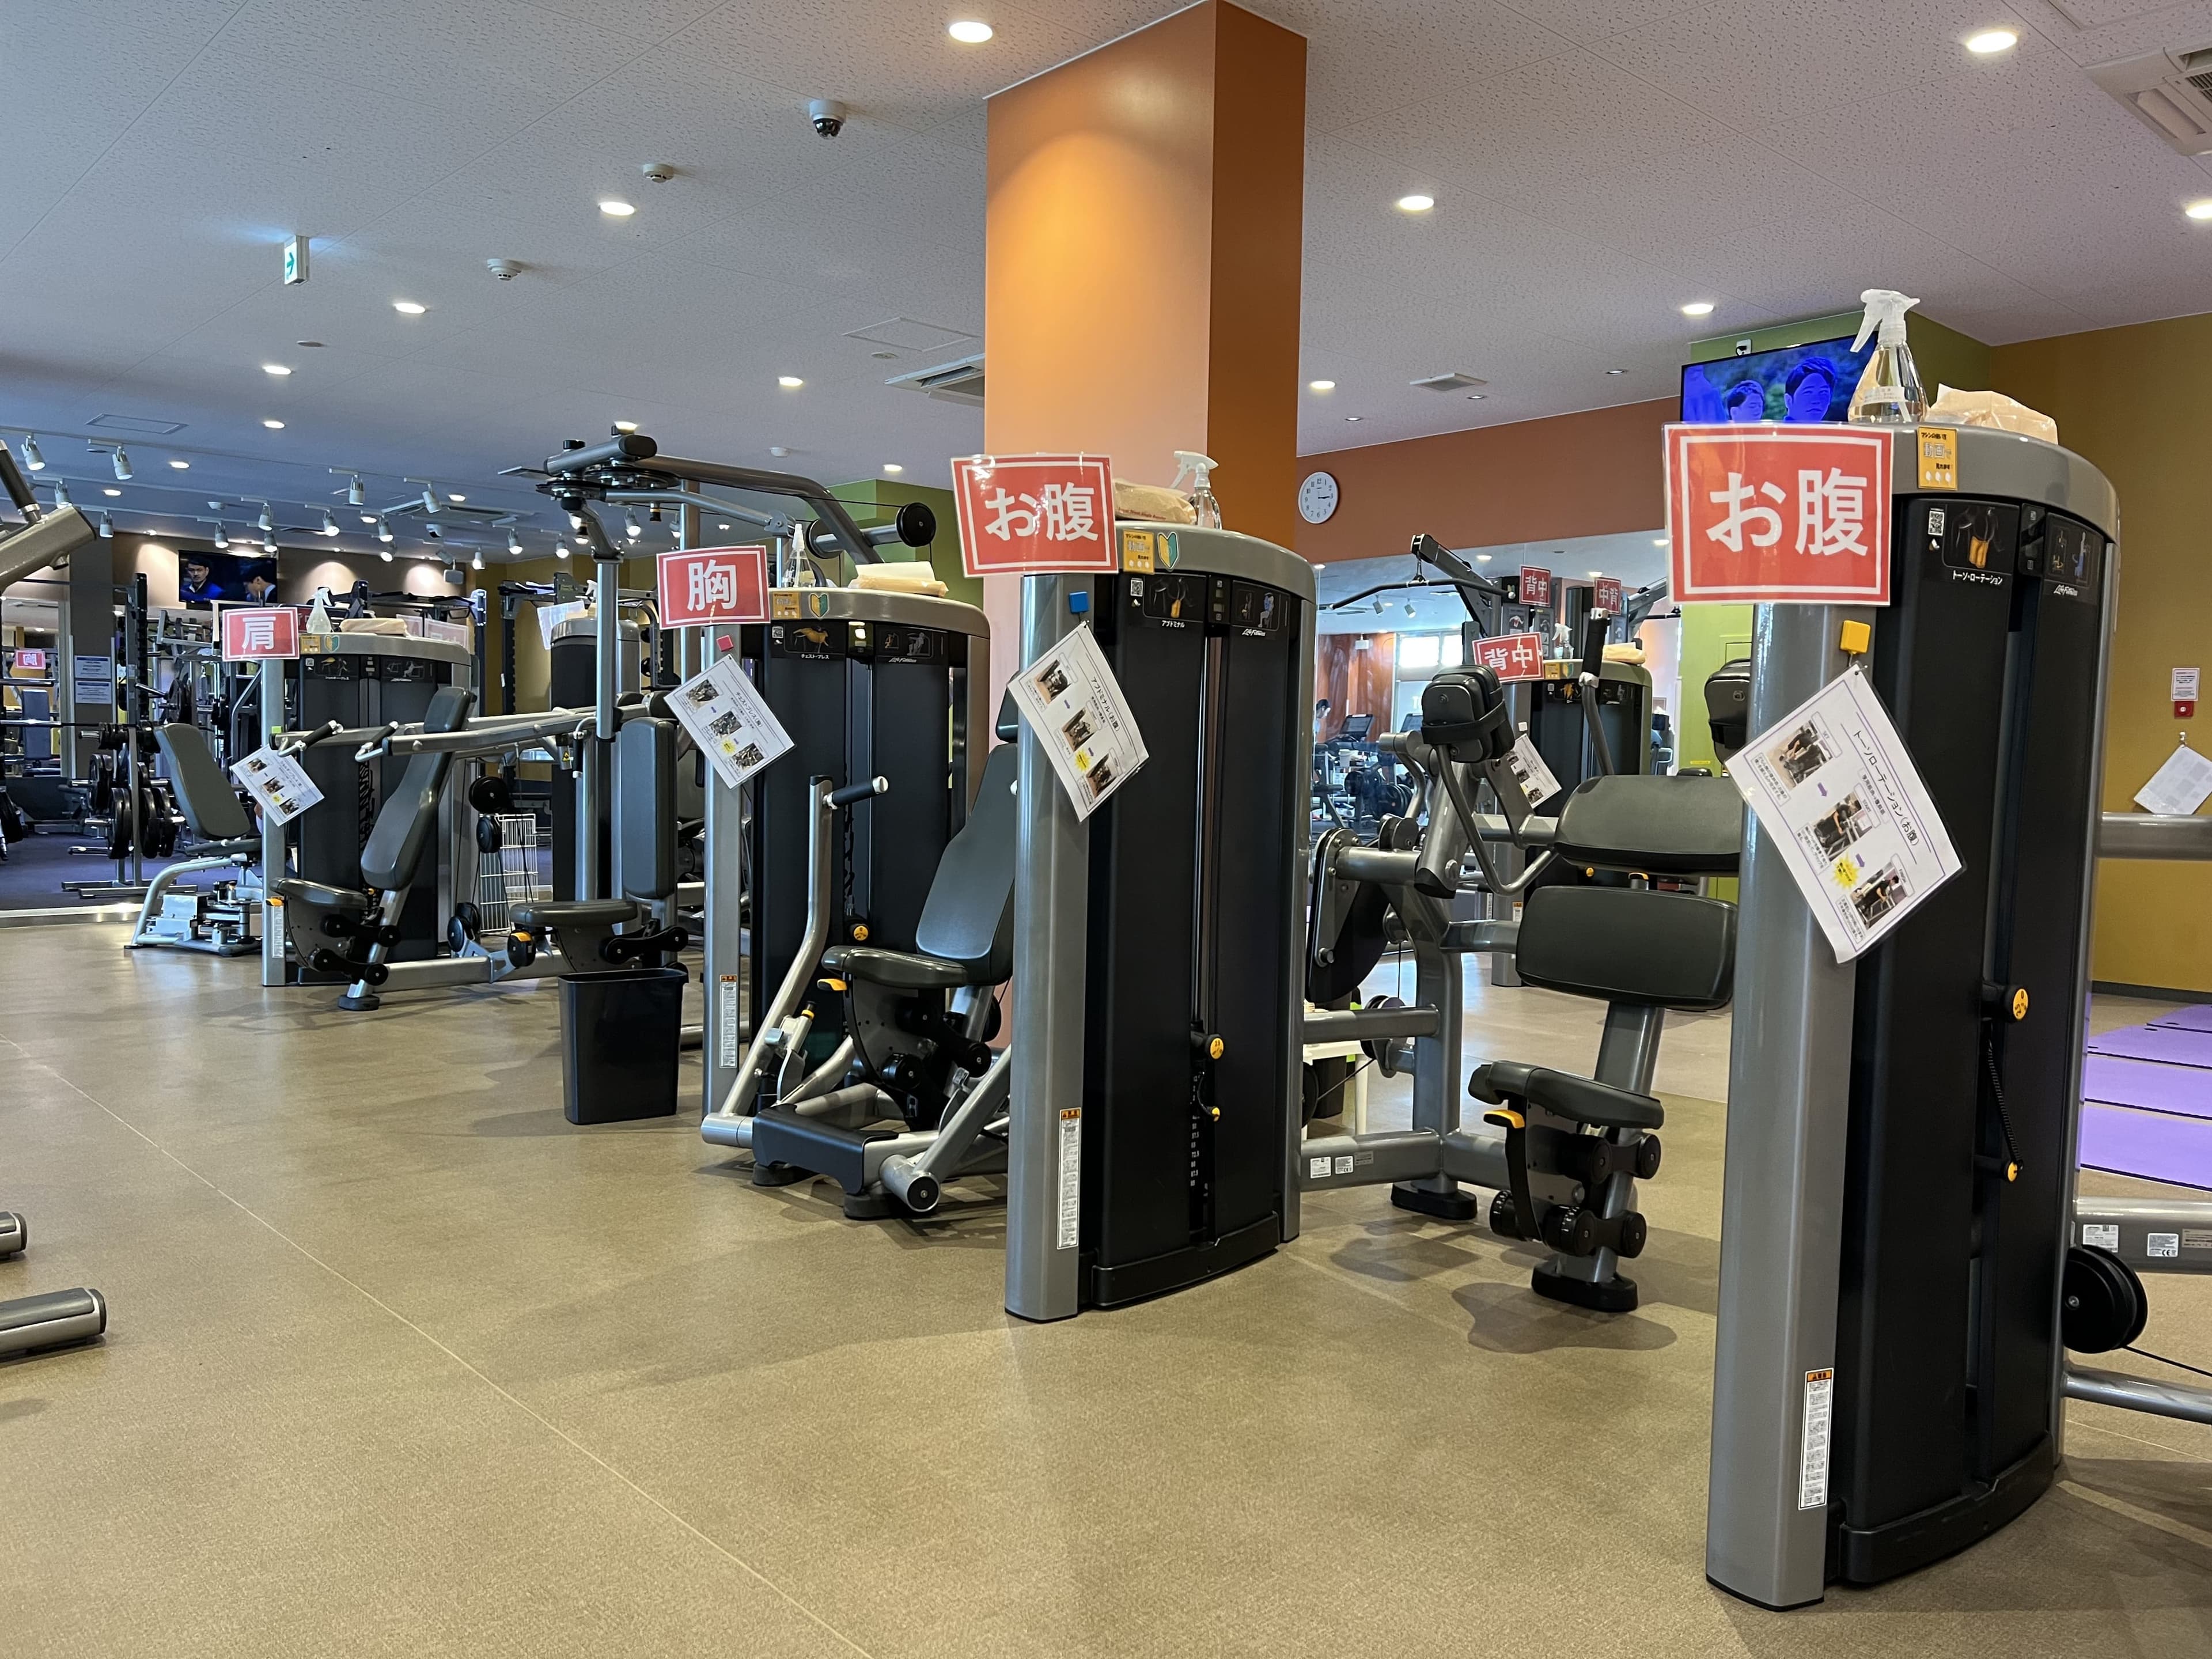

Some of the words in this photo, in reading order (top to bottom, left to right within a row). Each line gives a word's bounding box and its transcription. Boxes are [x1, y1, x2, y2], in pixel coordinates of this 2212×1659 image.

[984, 481, 1098, 541] お腹
[1706, 467, 1869, 556] お腹
[687, 559, 737, 611] 胸
[1525, 575, 1547, 597] 背中
[1953, 570, 2003, 585] トーソ・ローテーション
[242, 616, 276, 650] 肩
[1484, 645, 1533, 671] 背中
[1852, 729, 1922, 848] トーソローテーション(お腹)
